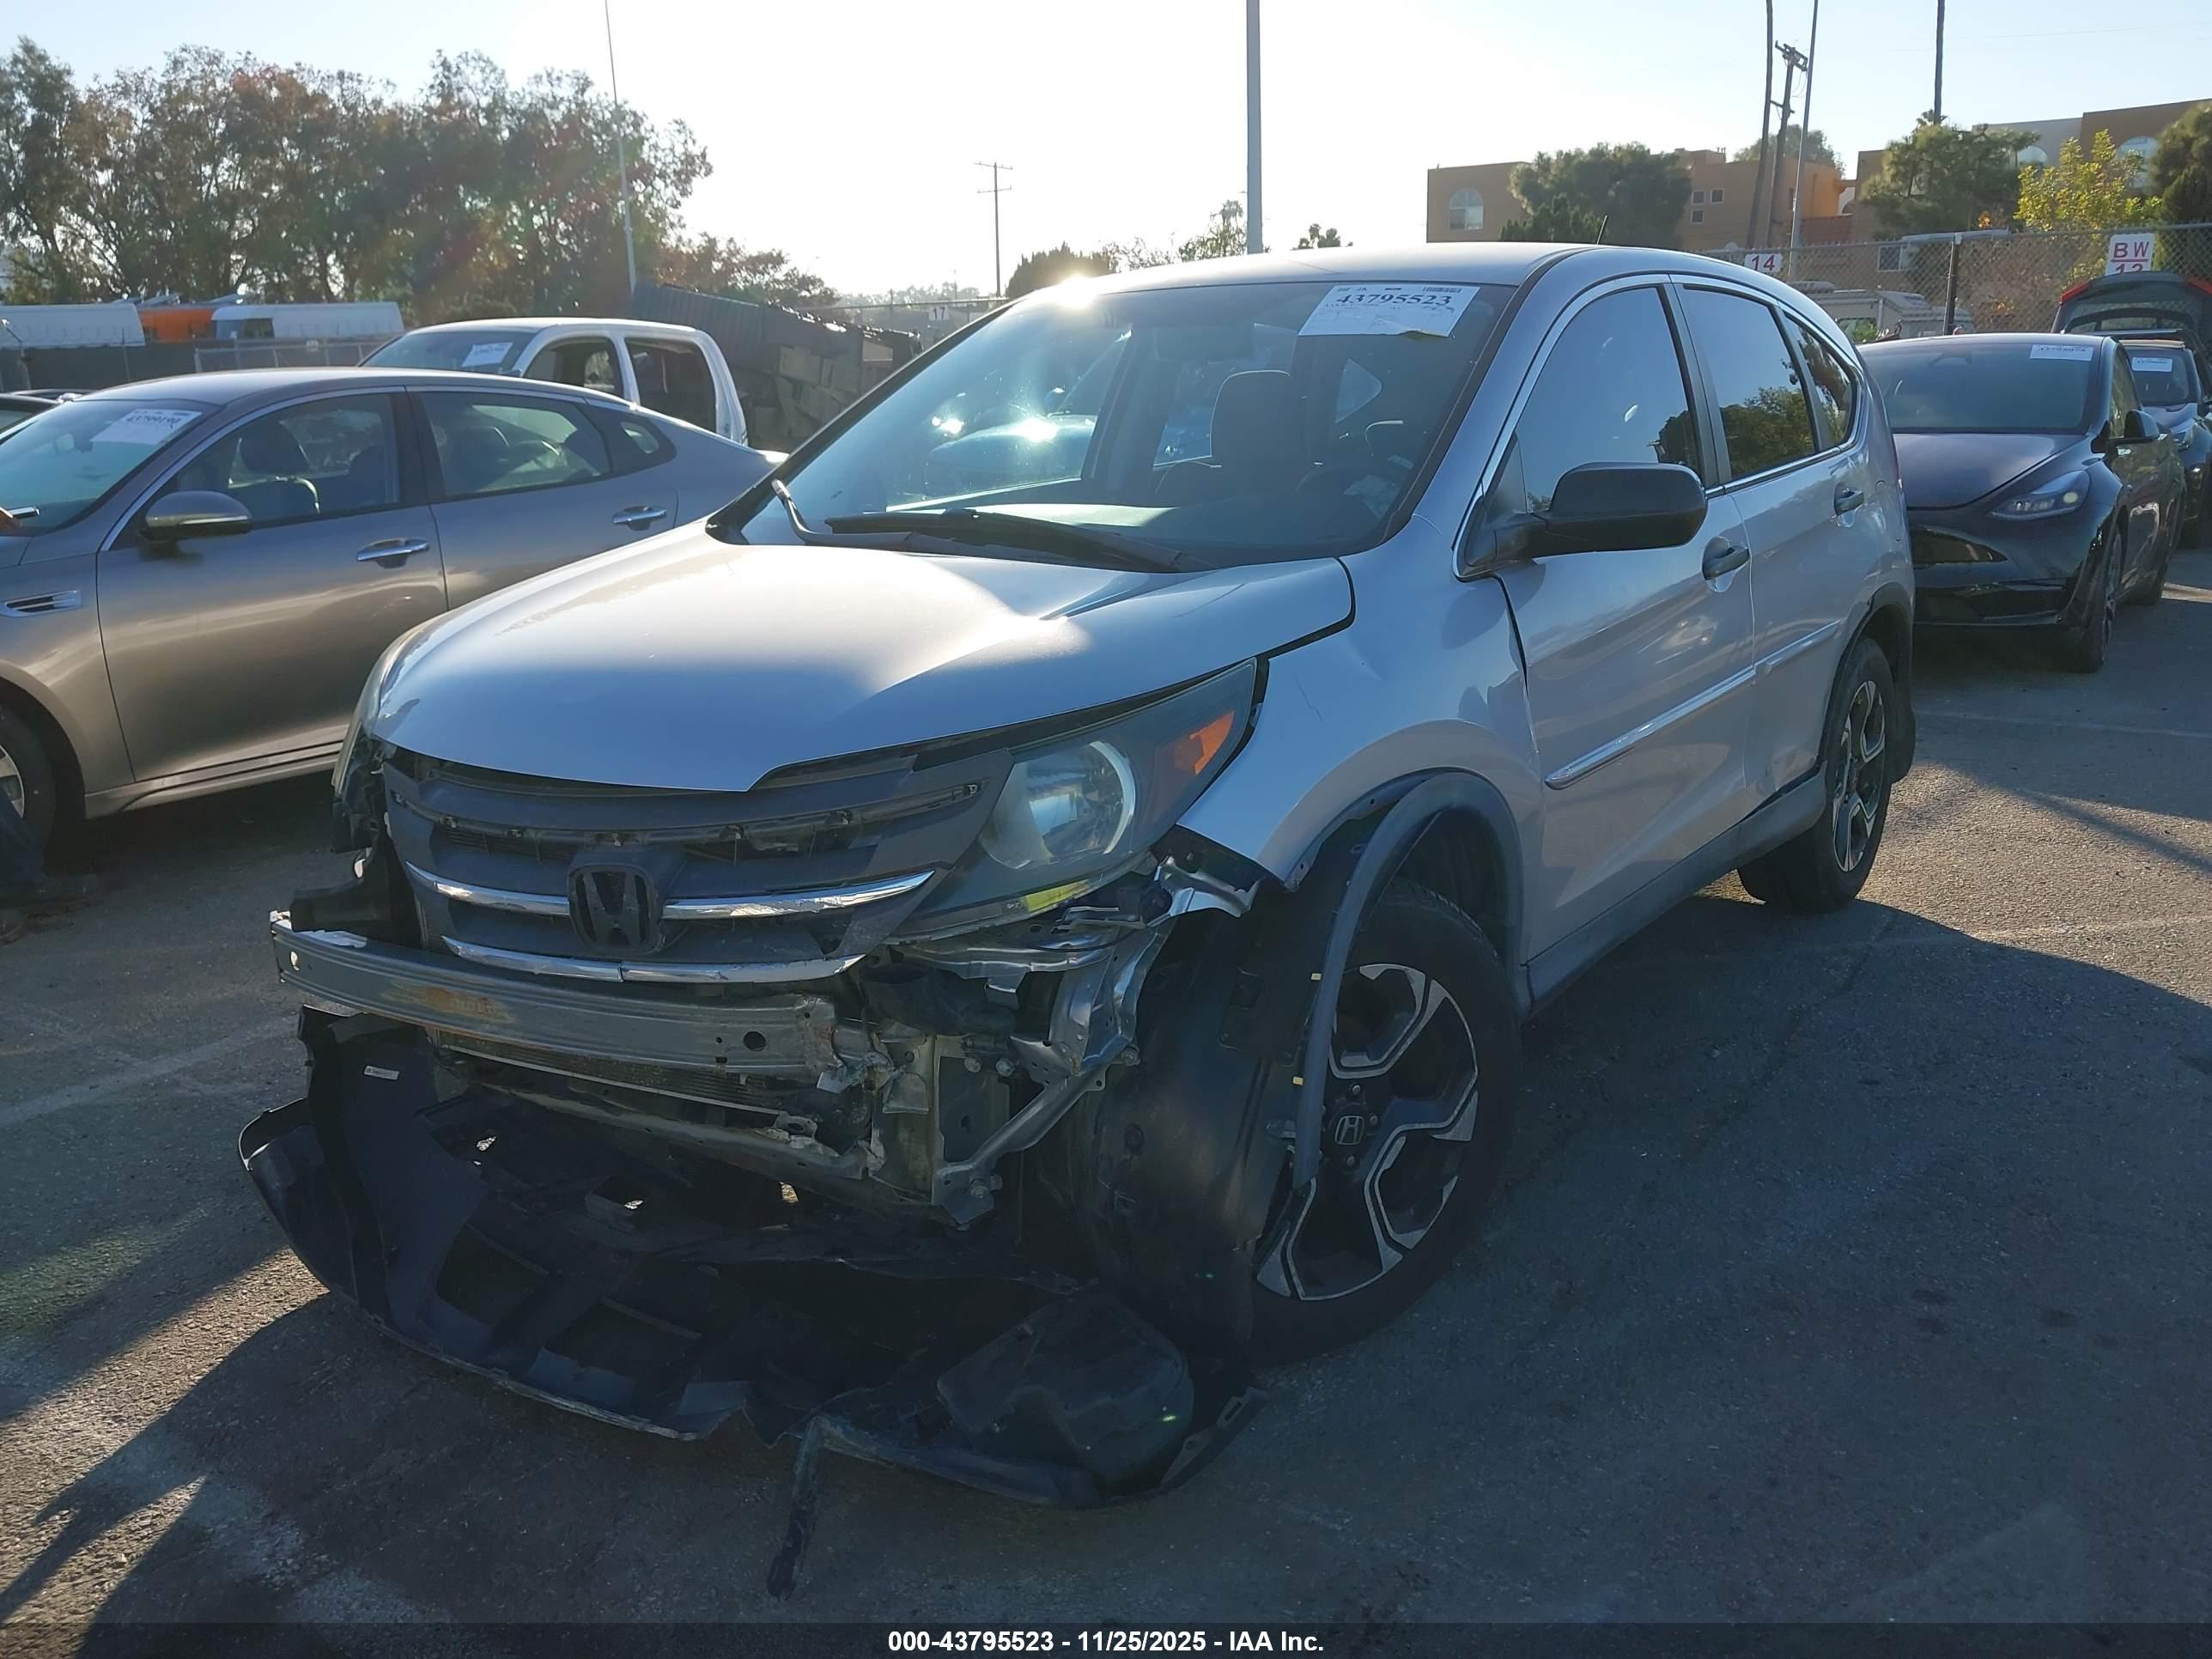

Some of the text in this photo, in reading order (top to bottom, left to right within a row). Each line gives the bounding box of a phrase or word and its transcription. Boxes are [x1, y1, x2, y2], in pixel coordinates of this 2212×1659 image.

[1751, 254, 1777, 270] 14
[1335, 293, 1453, 307] 43795523
[933, 307, 946, 319] 17
